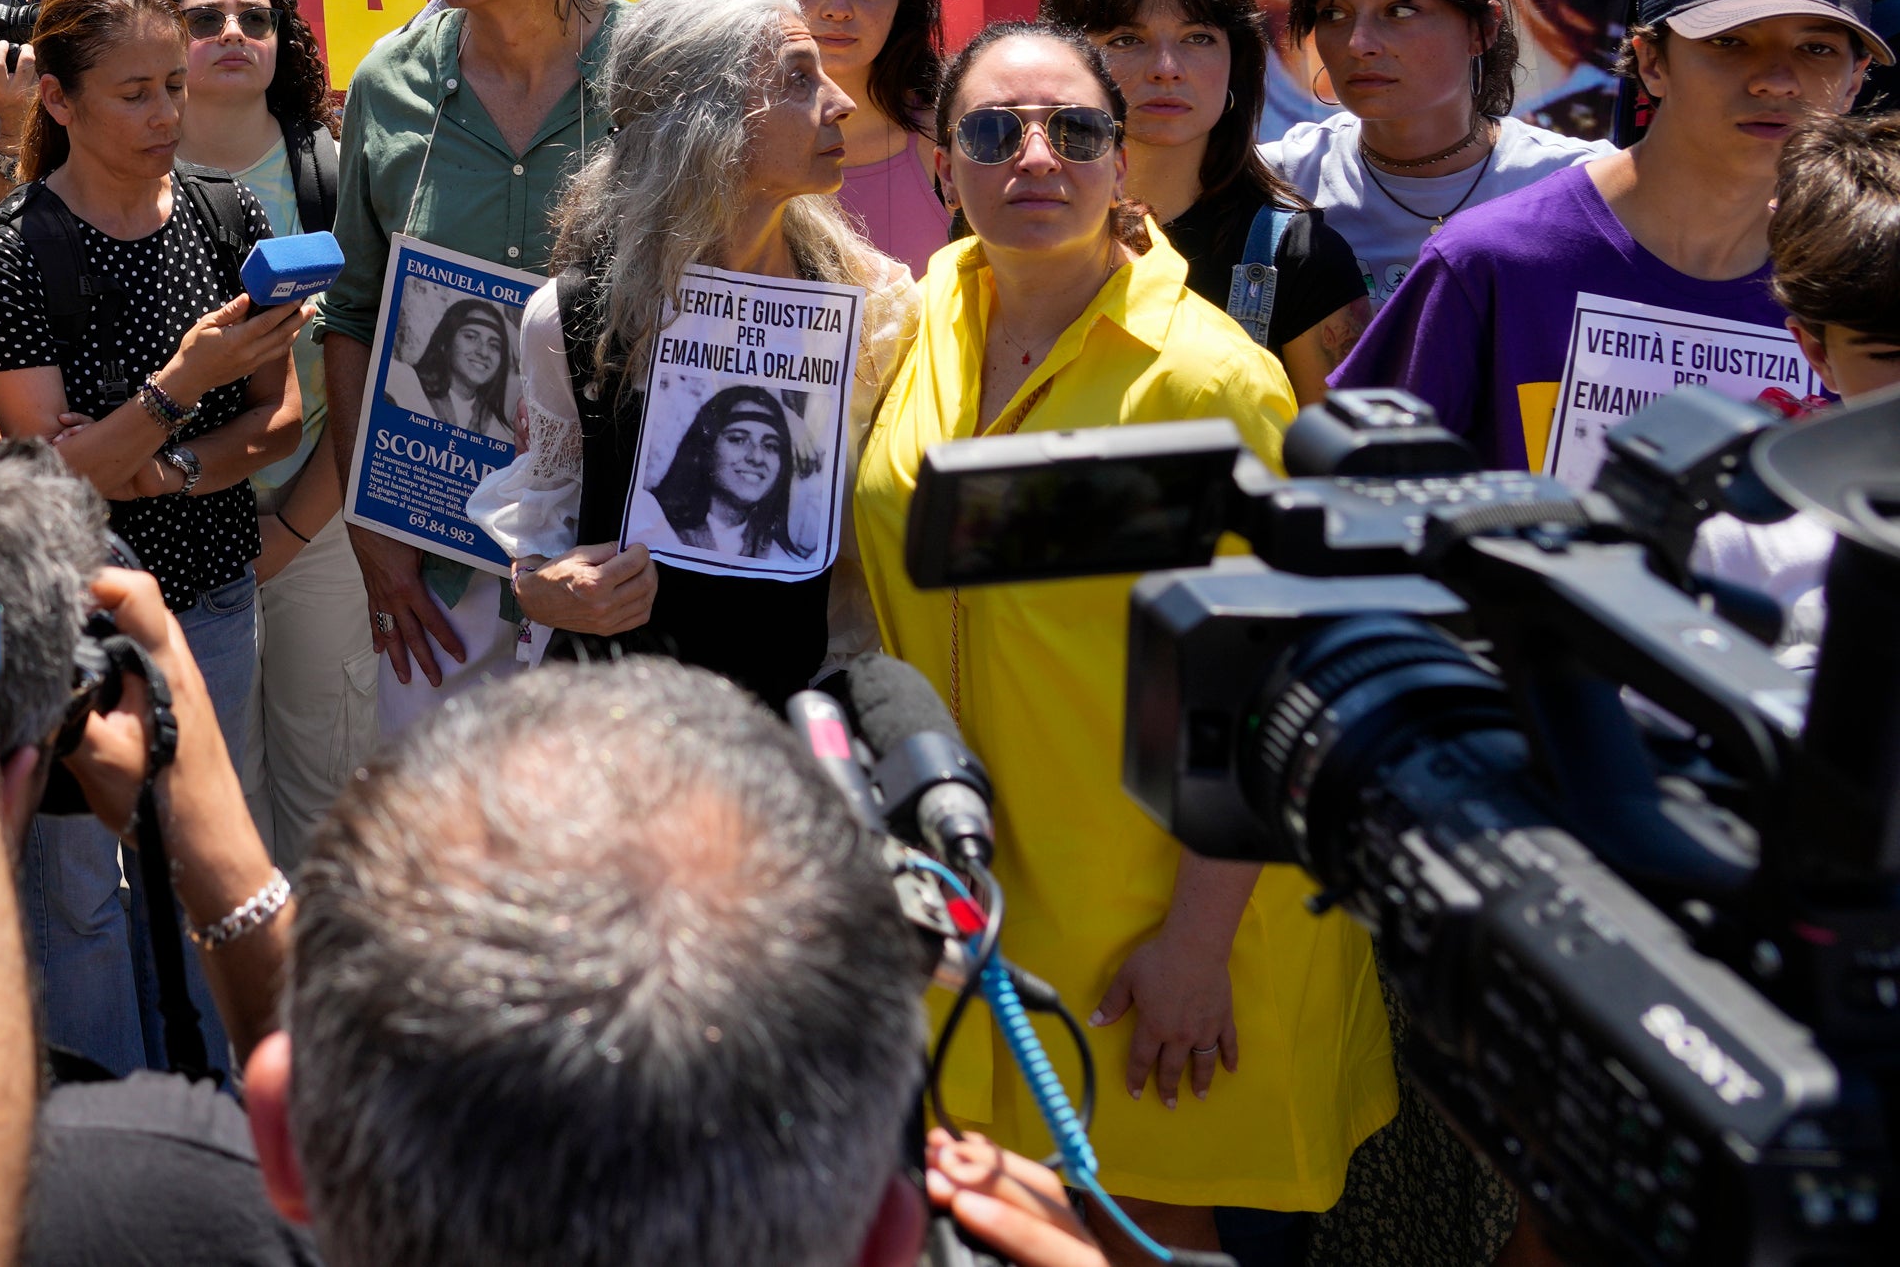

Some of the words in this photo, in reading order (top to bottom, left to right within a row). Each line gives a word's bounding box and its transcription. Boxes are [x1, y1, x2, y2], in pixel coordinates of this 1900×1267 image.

[275, 285, 292, 294] Rai
[294, 280, 326, 292] Radio
[406, 258, 486, 295] EMANUELA
[737, 296, 749, 322] E
[752, 299, 843, 334] GIUSTIZIA
[736, 325, 766, 348] PER
[660, 338, 757, 377] EMANUELA
[763, 352, 840, 386] ORLANDI
[1588, 326, 1664, 365] VERITÀ
[1671, 340, 1685, 367] E
[1691, 343, 1800, 384] GIUSTIZIA
[408, 413, 430, 427] Anni
[432, 421, 443, 433] 15
[451, 428, 468, 440] alta
[470, 435, 484, 446] mt.
[488, 439, 508, 453] 1,60
[448, 438, 457, 453] È
[370, 466, 391, 479] bianca
[398, 476, 419, 489] scarpe
[419, 482, 428, 491] da
[429, 485, 463, 504] ginnastica.
[371, 459, 385, 468] neri
[395, 465, 410, 478] lisci,
[413, 474, 444, 489] indossava
[382, 455, 412, 470] momento
[412, 464, 428, 475] della
[429, 470, 462, 488] scomparsa
[367, 490, 398, 506] telefonare
[398, 500, 406, 508] al
[406, 504, 432, 518] numero
[368, 482, 377, 490] 22
[376, 485, 400, 499] giugno,
[400, 492, 411, 502] chi
[411, 496, 431, 509] avesse
[431, 503, 445, 514] utili
[369, 474, 383, 485] Non
[384, 479, 391, 487] si
[390, 481, 411, 494] hanno
[411, 488, 423, 498] sue
[423, 491, 445, 505] notizie
[445, 500, 462, 512] dalle
[408, 514, 476, 545] 69.84.982
